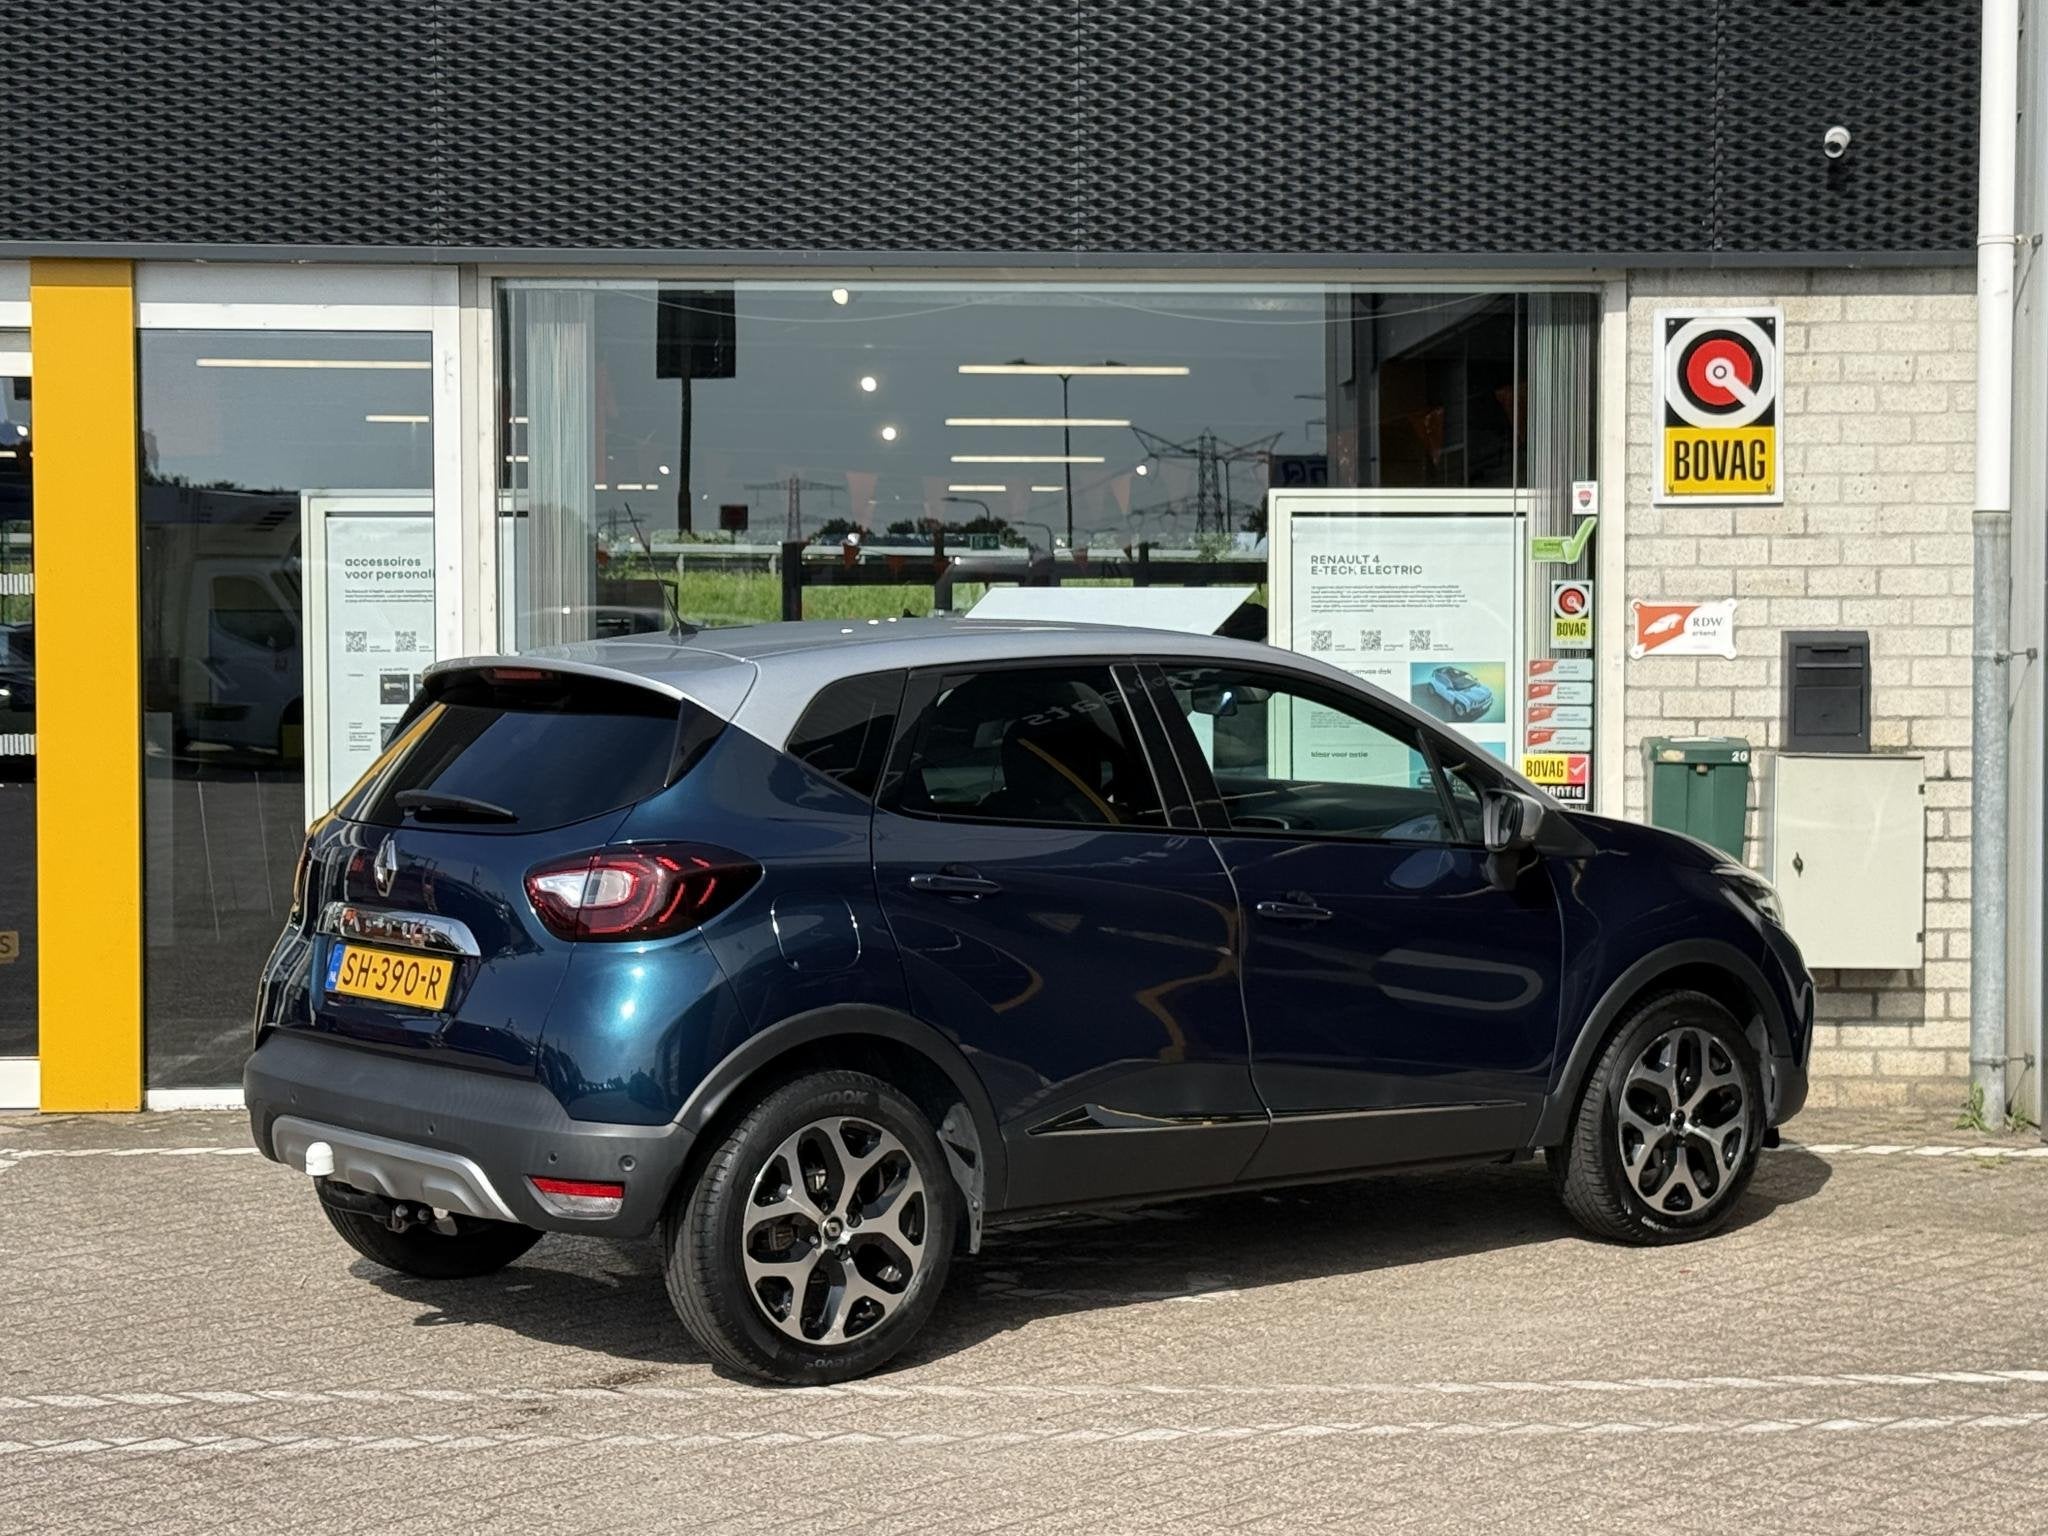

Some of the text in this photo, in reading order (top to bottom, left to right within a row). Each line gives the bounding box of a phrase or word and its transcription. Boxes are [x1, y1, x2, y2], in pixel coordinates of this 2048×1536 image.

[1673, 439, 1766, 481] BOVAG
[344, 556, 421, 567] accessoires
[1311, 554, 1380, 565] RENAULT 4
[344, 571, 374, 579] voor
[1360, 565, 1423, 575] ELECTRIC
[1692, 616, 1724, 627] RDW
[1556, 622, 1587, 637] BOVAG
[1731, 750, 1749, 762] 20
[1526, 759, 1564, 778] BOVAG
[1540, 785, 1584, 798] ANTIE
[342, 952, 442, 1001] SH-390-R
